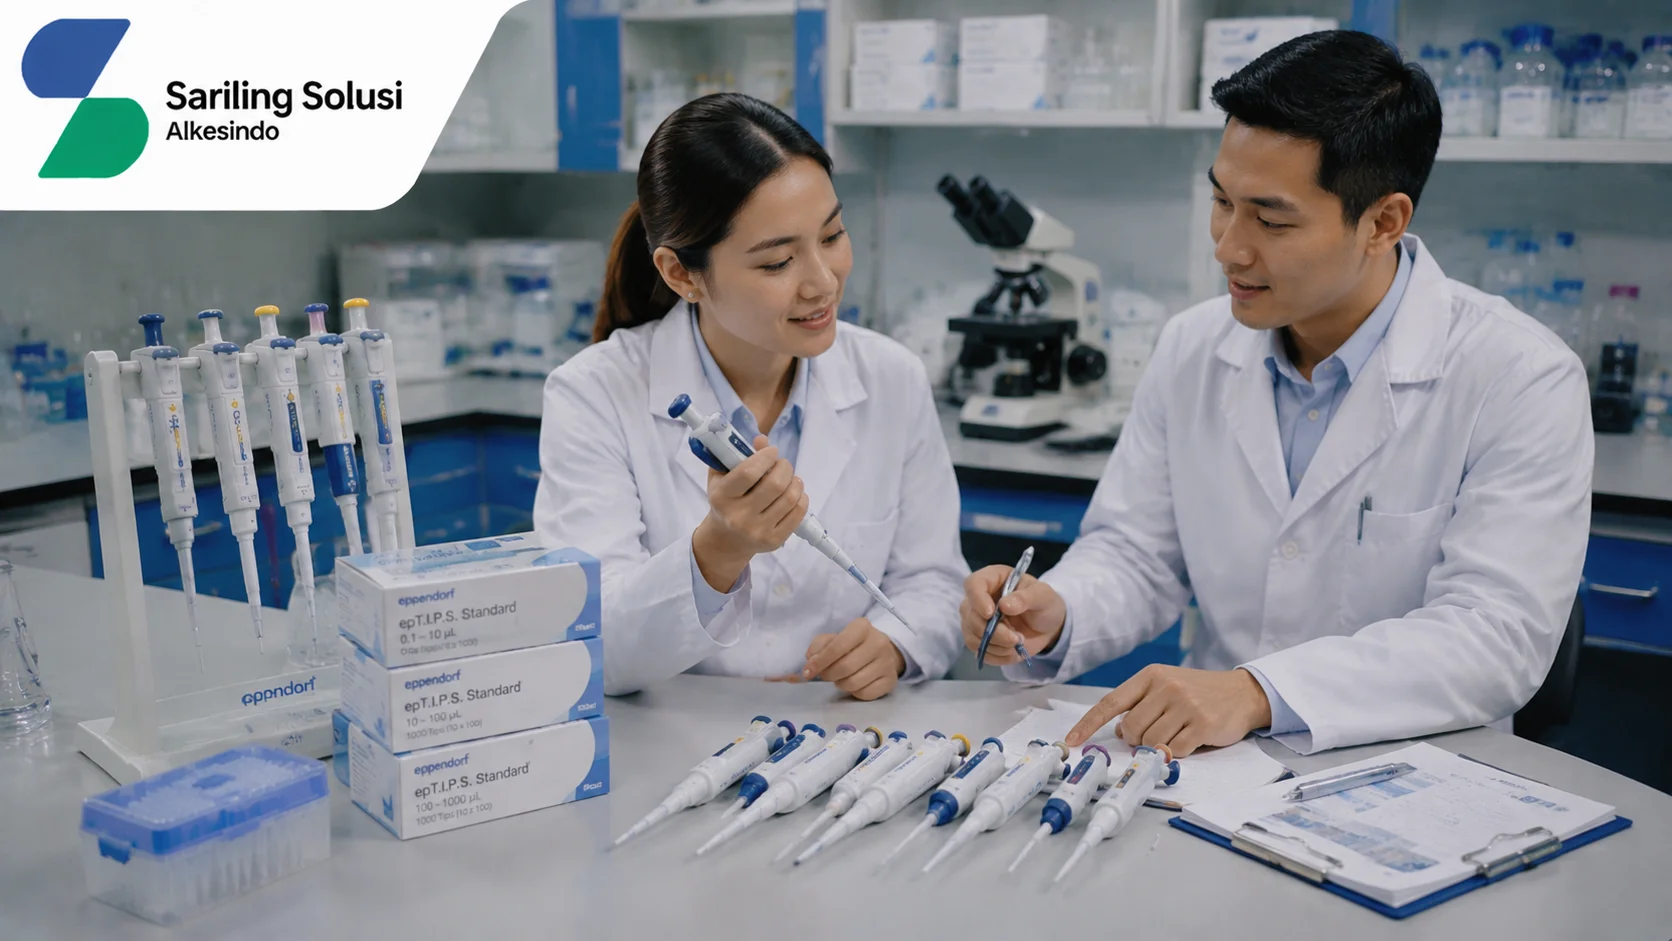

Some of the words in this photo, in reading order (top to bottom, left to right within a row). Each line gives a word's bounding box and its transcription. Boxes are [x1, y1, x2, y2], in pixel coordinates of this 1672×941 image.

[398, 587, 455, 607] eppendorf
[399, 610, 458, 630] epT.I.P.S.
[461, 600, 517, 621] Standard
[404, 669, 461, 690] eppendorf
[404, 691, 464, 713] epT.I.P.S.
[466, 681, 522, 702] Standard
[406, 717, 418, 728] 10
[429, 711, 447, 724] 100
[414, 753, 469, 777] eppendorf
[414, 775, 473, 799] epT.I.P.S.
[475, 762, 530, 785] Standard
[416, 800, 433, 813] 100
[443, 794, 466, 808] 1000
